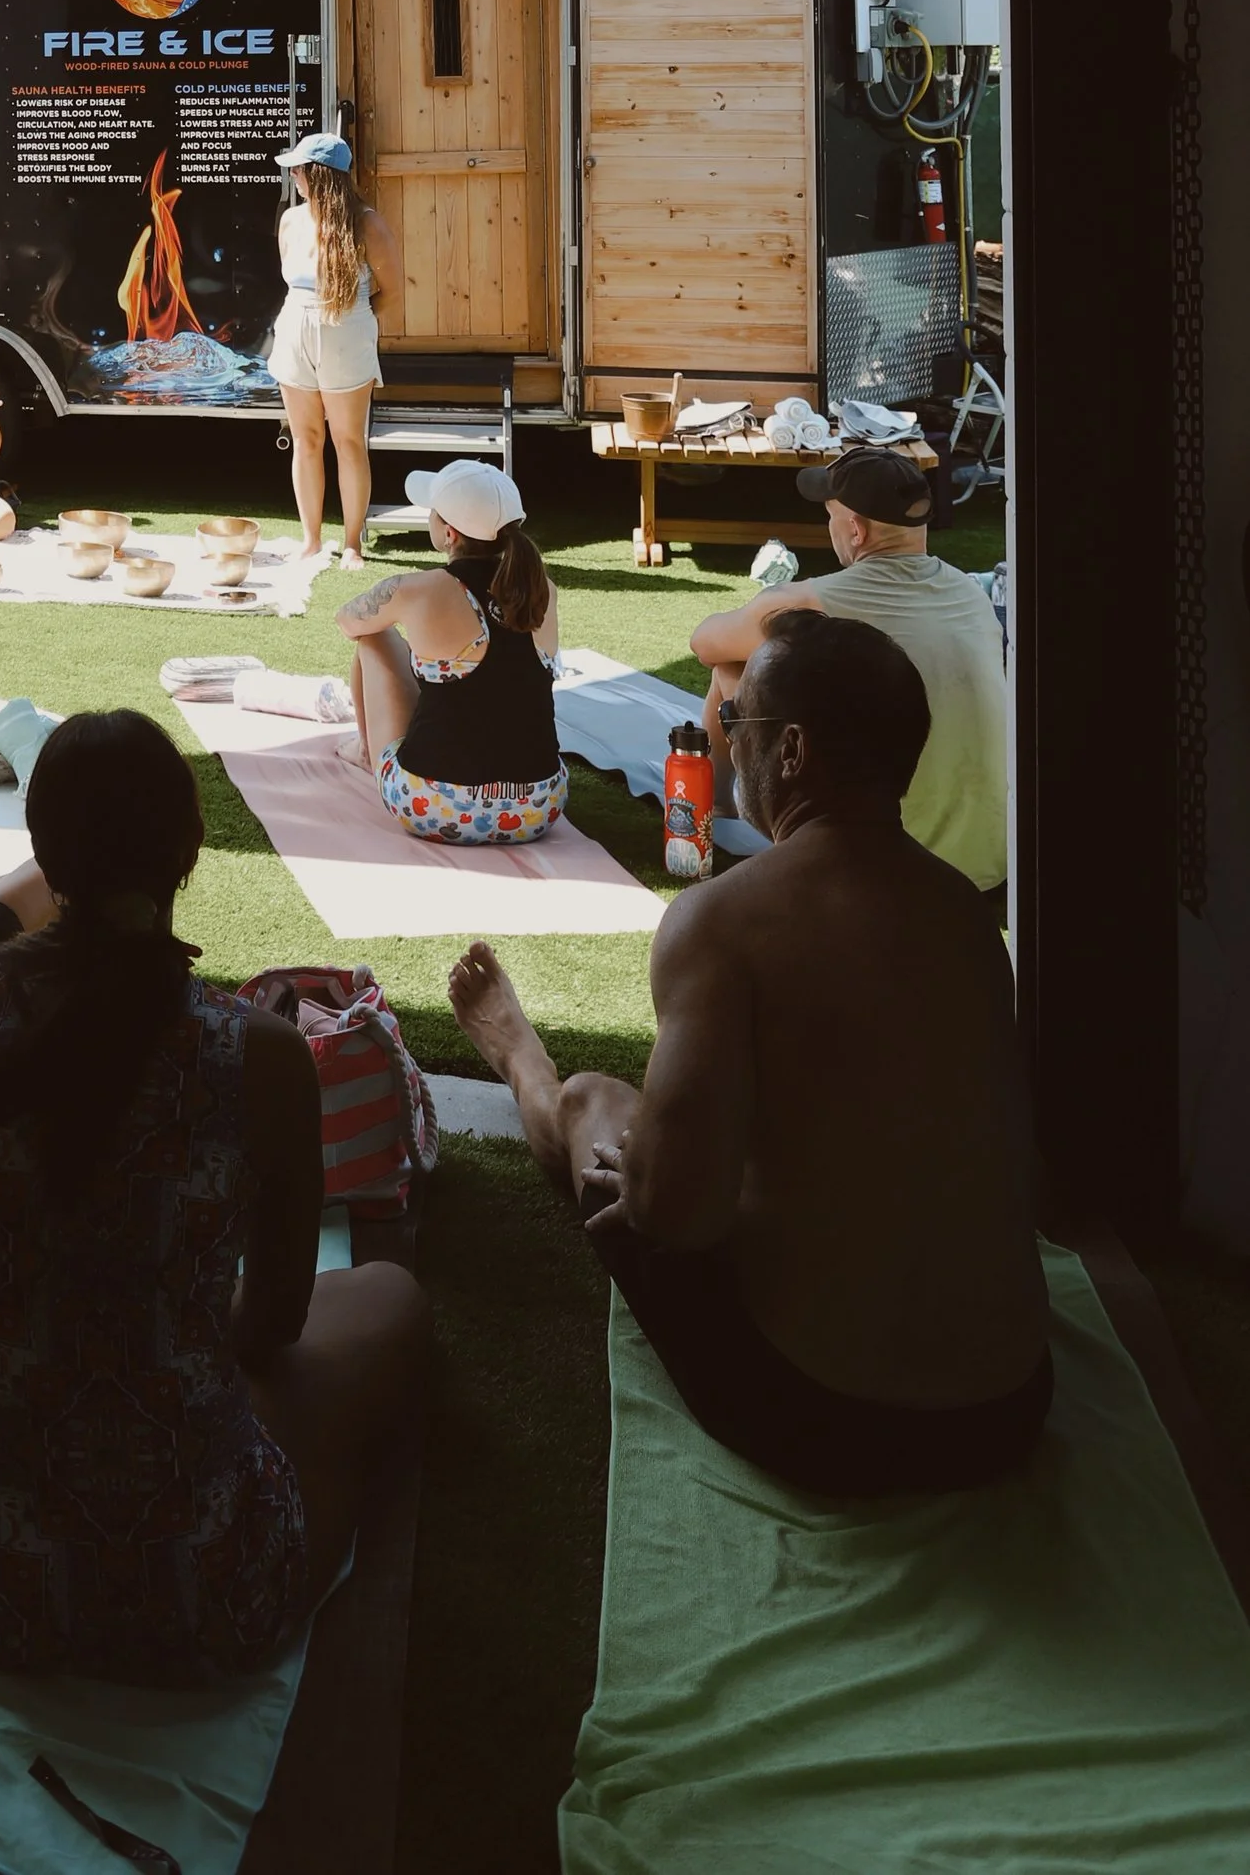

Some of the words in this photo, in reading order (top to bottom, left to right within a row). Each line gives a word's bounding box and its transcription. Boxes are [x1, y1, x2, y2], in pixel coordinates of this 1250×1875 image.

[44, 30, 145, 57] FIRE
[159, 30, 188, 56] &
[202, 29, 275, 55] ICE
[65, 62, 129, 71] WOOD-FIRED
[133, 62, 167, 70] SAUNA
[179, 61, 206, 69] COLD
[209, 61, 249, 69] PLUNGE
[12, 86, 47, 95] SAUNA
[51, 86, 92, 95] HEALTH
[96, 85, 146, 94] BENEFITS
[175, 85, 204, 93] COLD
[208, 85, 251, 93] PLUNGE
[255, 84, 306, 93] BENEFTS
[16, 99, 52, 107] LOWERS
[223, 97, 290, 105] INFLAMMATION
[17, 110, 59, 118] IMPROVES
[94, 110, 122, 118] FLOW,
[17, 121, 76, 129] CIRCULATION,
[130, 120, 155, 128] RATE.
[98, 131, 137, 139] PROCESS
[265, 130, 302, 138] CLARY
[54, 175, 70, 183] THE
[73, 175, 106, 183] IMMUNE
[108, 175, 141, 183] SYSTEM
[233, 175, 282, 183] TESTOSTER
